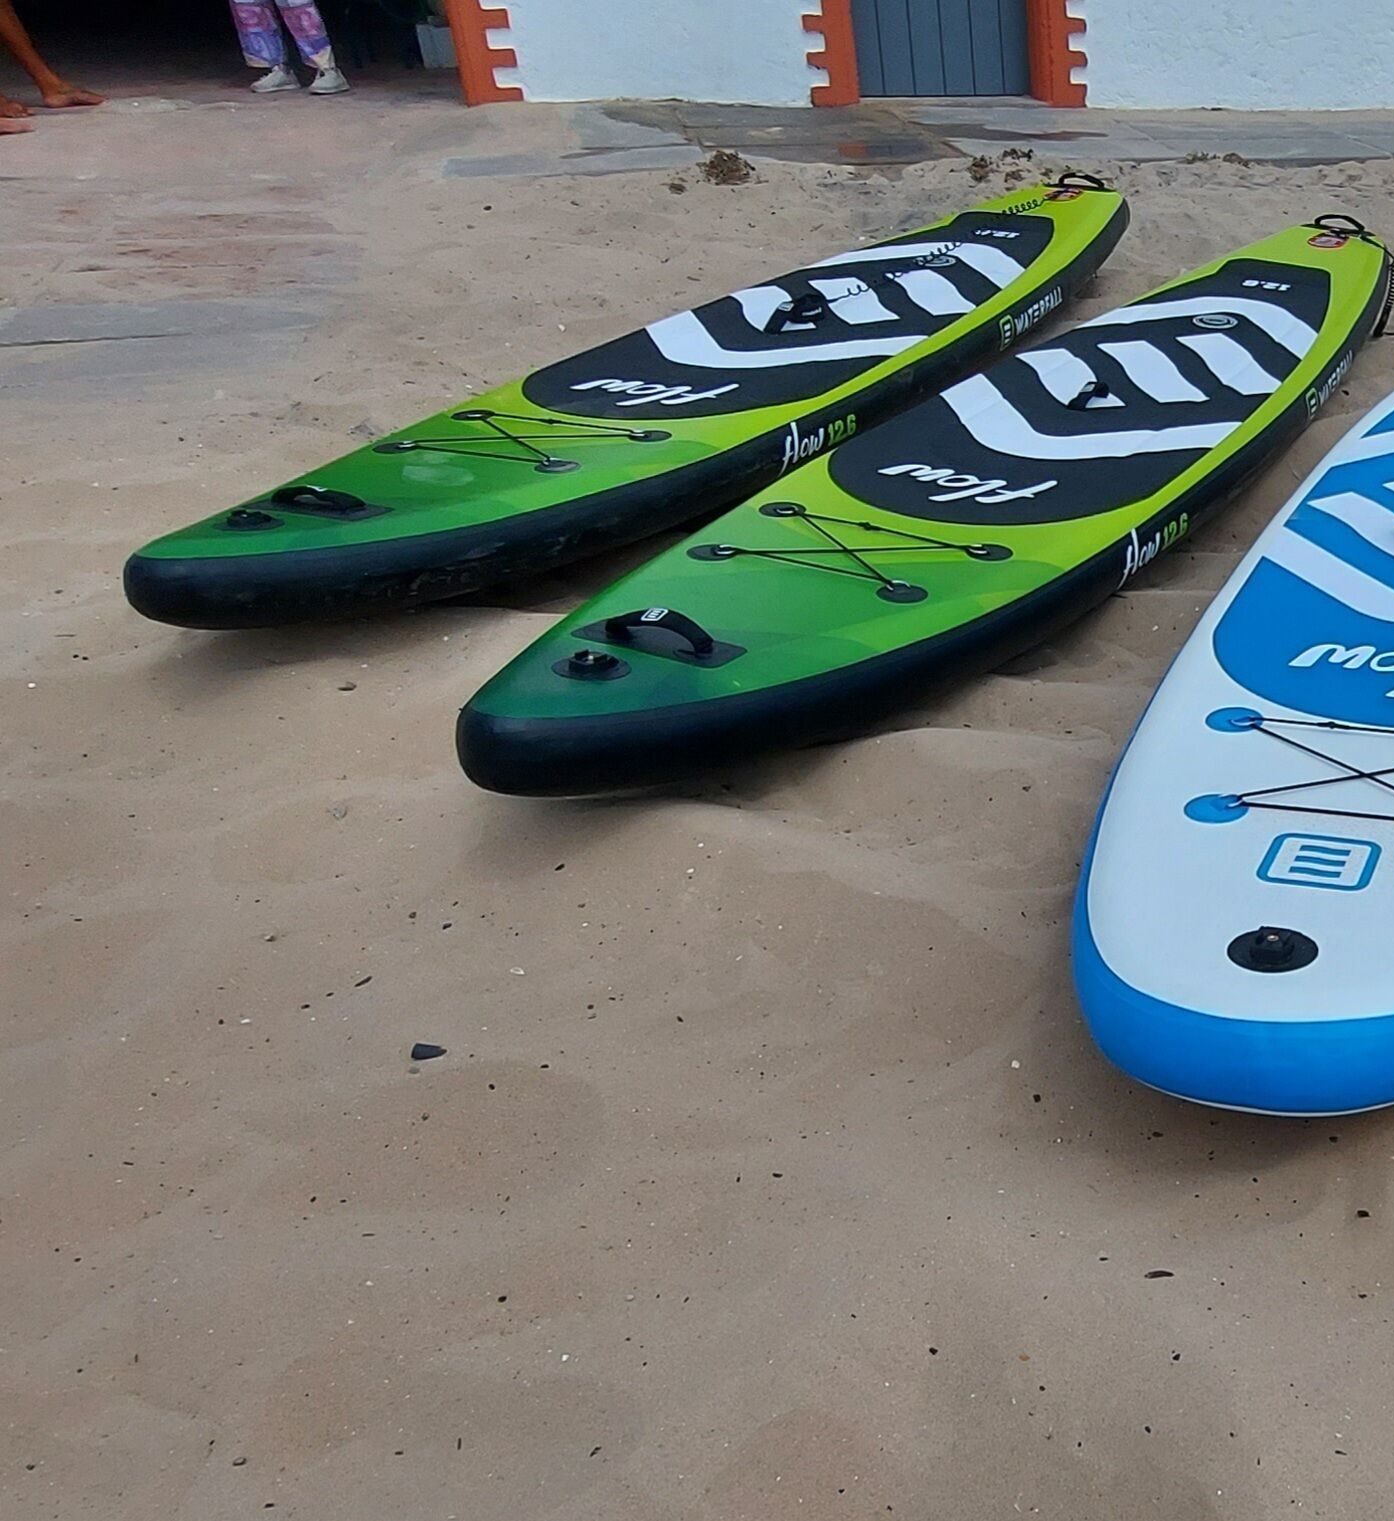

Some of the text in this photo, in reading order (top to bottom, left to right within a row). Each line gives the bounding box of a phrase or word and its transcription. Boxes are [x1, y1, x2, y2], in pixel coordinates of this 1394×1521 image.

[1014, 285, 1063, 336] WATERFALL
[569, 379, 740, 406] flow
[777, 421, 825, 478] flow
[877, 463, 1058, 504] flow
